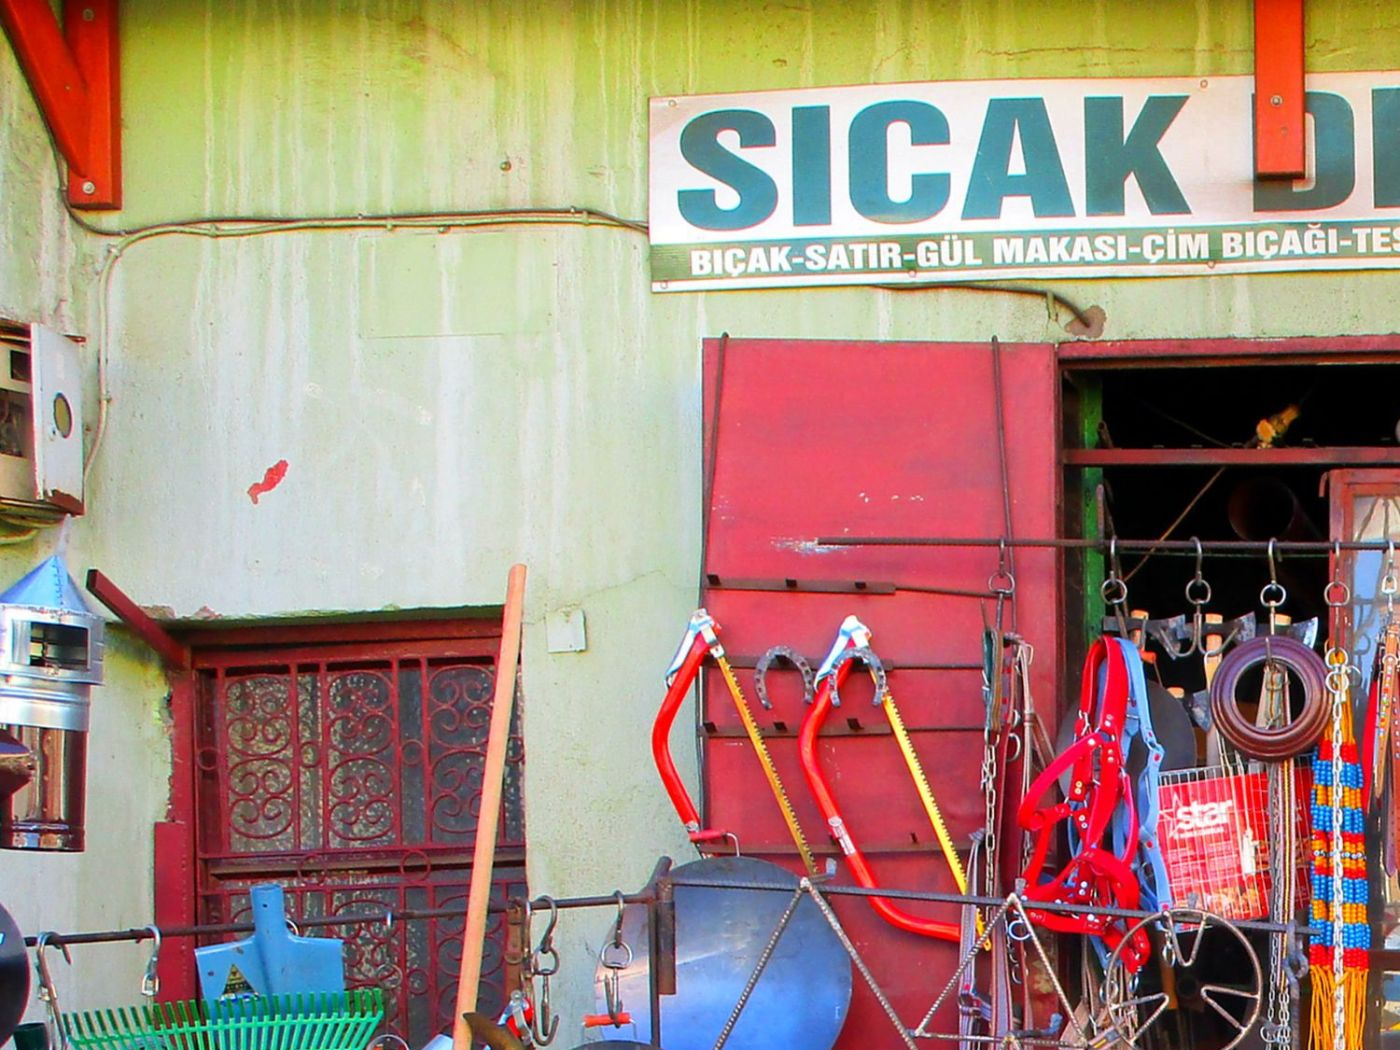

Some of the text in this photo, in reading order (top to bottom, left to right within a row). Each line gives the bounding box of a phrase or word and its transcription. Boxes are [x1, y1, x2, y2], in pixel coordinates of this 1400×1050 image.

[677, 94, 1192, 231] SICAK
[690, 235, 982, 278] BIÇAK-SATIR-GÜL
[993, 228, 1210, 264] MAKASI-ÇİM
[1177, 800, 1232, 830] star
